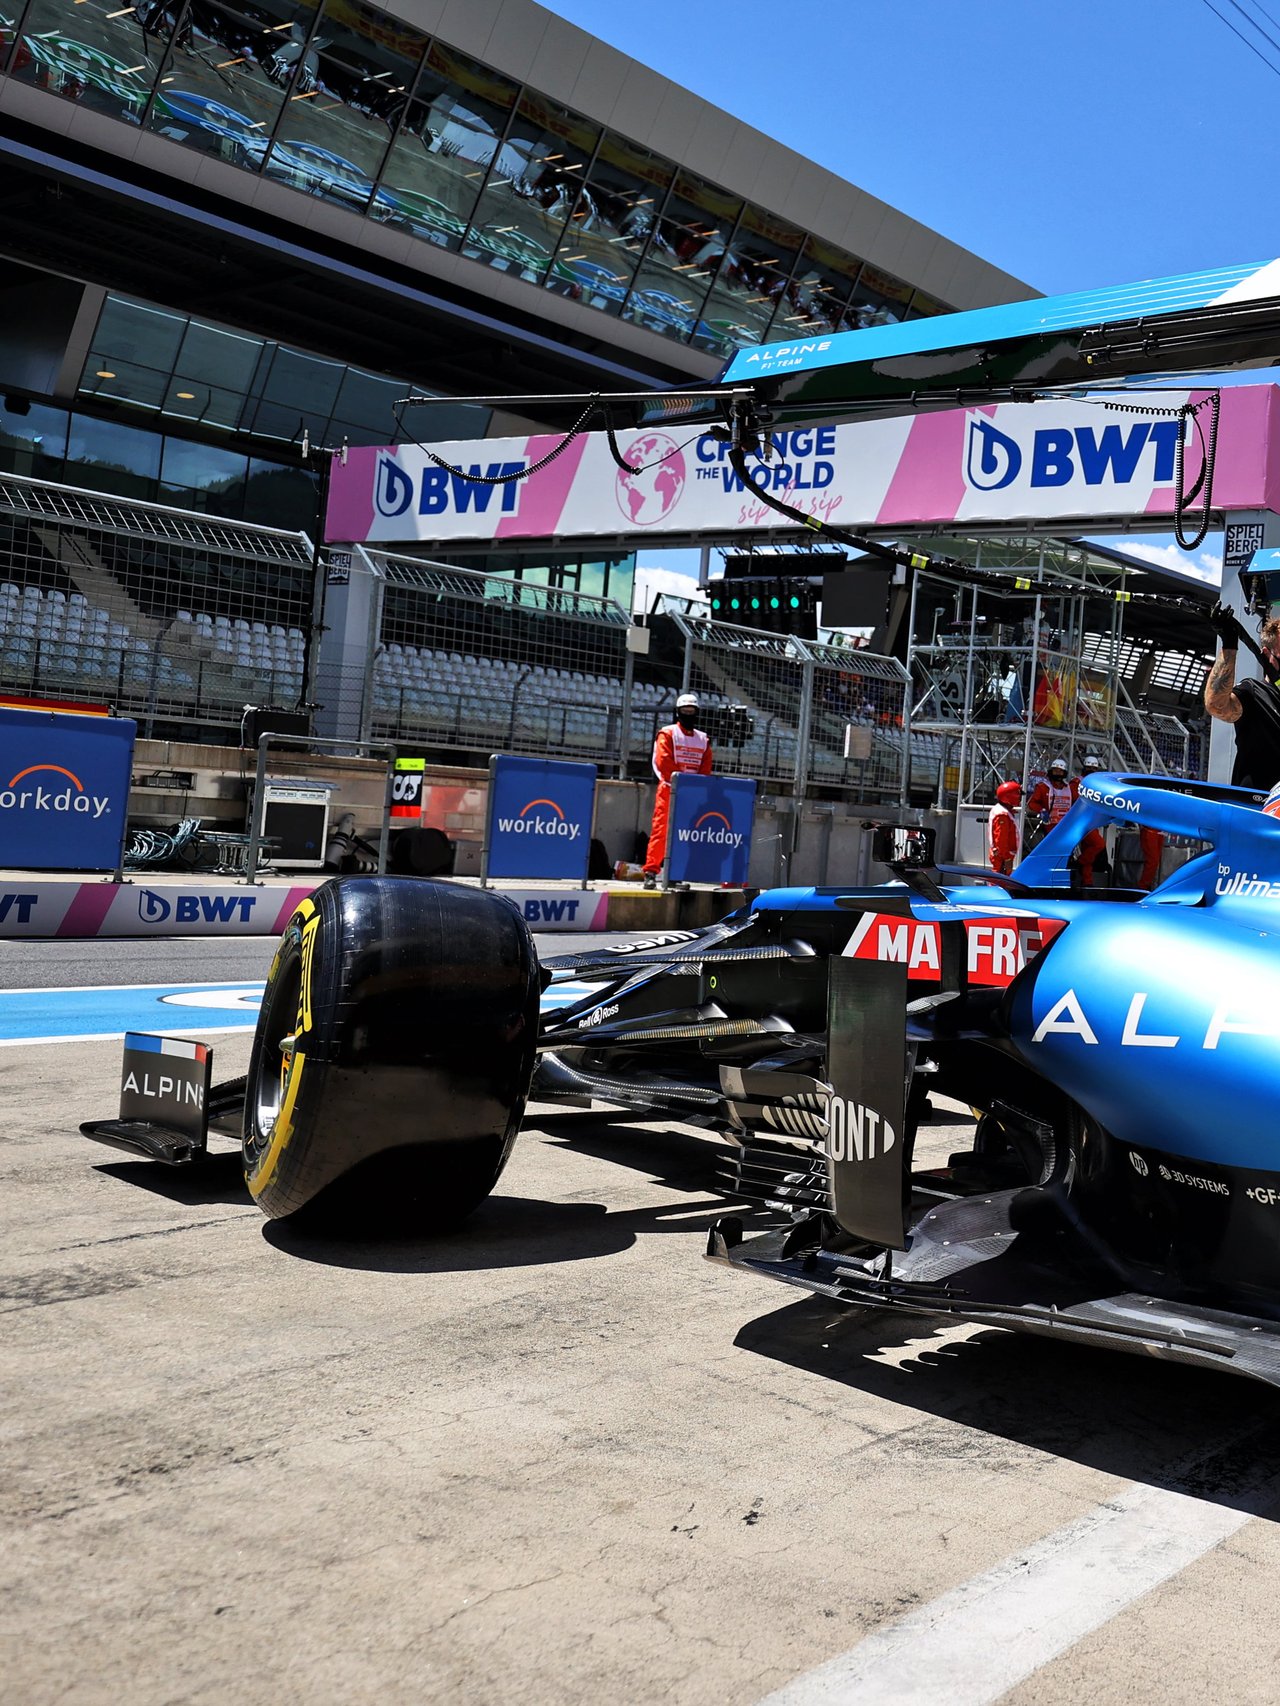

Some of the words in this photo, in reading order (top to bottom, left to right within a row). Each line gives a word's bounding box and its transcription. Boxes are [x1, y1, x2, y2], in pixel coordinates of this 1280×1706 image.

[746, 341, 832, 362] ALPINE
[777, 357, 803, 368] TEAM
[696, 424, 837, 463] CHANGE
[1030, 420, 1188, 488] BWT
[418, 461, 526, 516] BWT
[696, 467, 719, 480] THE
[722, 461, 835, 493] WORLD
[738, 499, 771, 525] sip
[809, 490, 843, 522] sip
[1228, 525, 1263, 539] SPIEL
[1227, 539, 1258, 553] BERG
[498, 815, 579, 838] workday
[678, 827, 741, 849] workday
[1218, 863, 1230, 876] bp
[175, 896, 256, 922] BWT
[524, 900, 579, 922] BWT
[878, 924, 1043, 977] MAFRE
[602, 1004, 619, 1018] Ross
[1171, 1169, 1185, 1183] 3D
[1184, 1174, 1230, 1196] SYSTEMS
